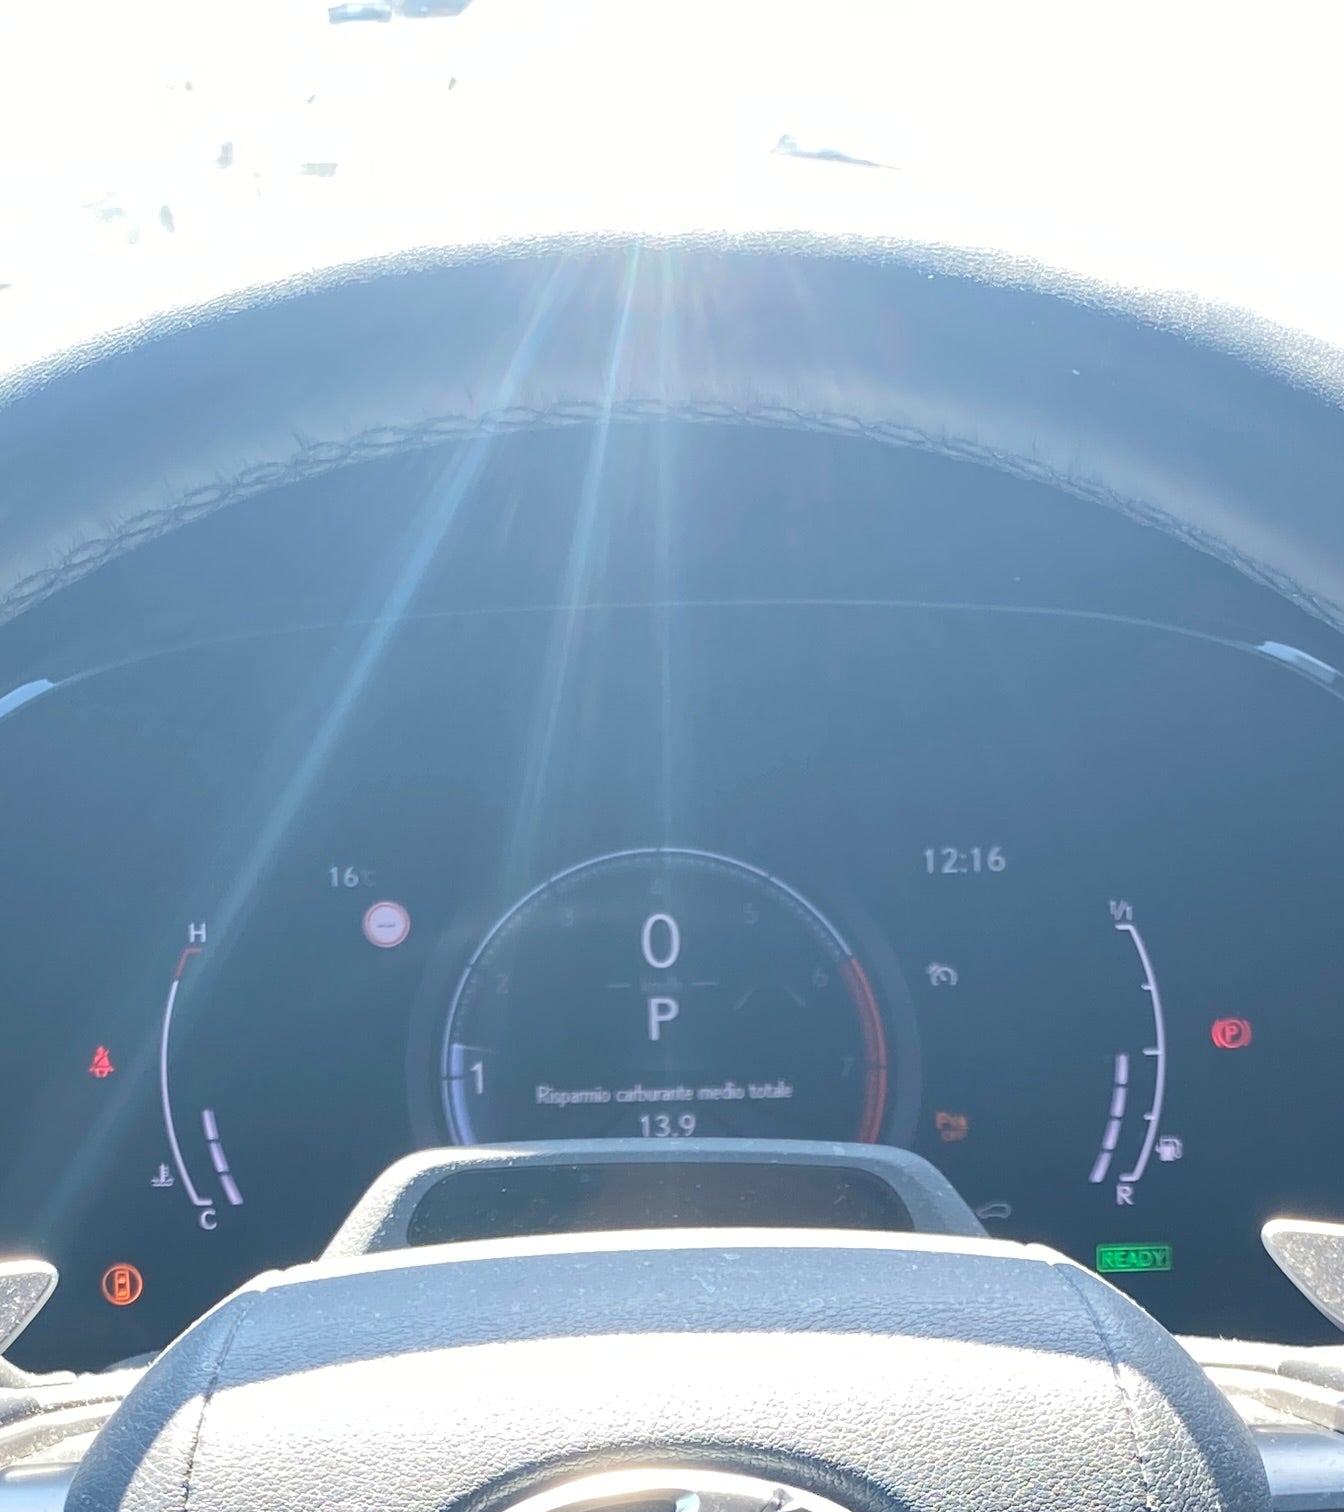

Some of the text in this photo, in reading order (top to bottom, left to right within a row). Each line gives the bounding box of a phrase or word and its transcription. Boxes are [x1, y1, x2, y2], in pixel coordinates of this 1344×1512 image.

[923, 847, 1006, 874] 12:16
[188, 922, 207, 943] H
[648, 998, 680, 1041] P
[469, 1062, 485, 1094] 1
[535, 1080, 794, 1107] Risparmio carburante medio totale
[640, 1113, 697, 1137] 13.9
[1116, 1184, 1134, 1205] R
[200, 1210, 217, 1230] C
[1102, 1249, 1169, 1269] READY
